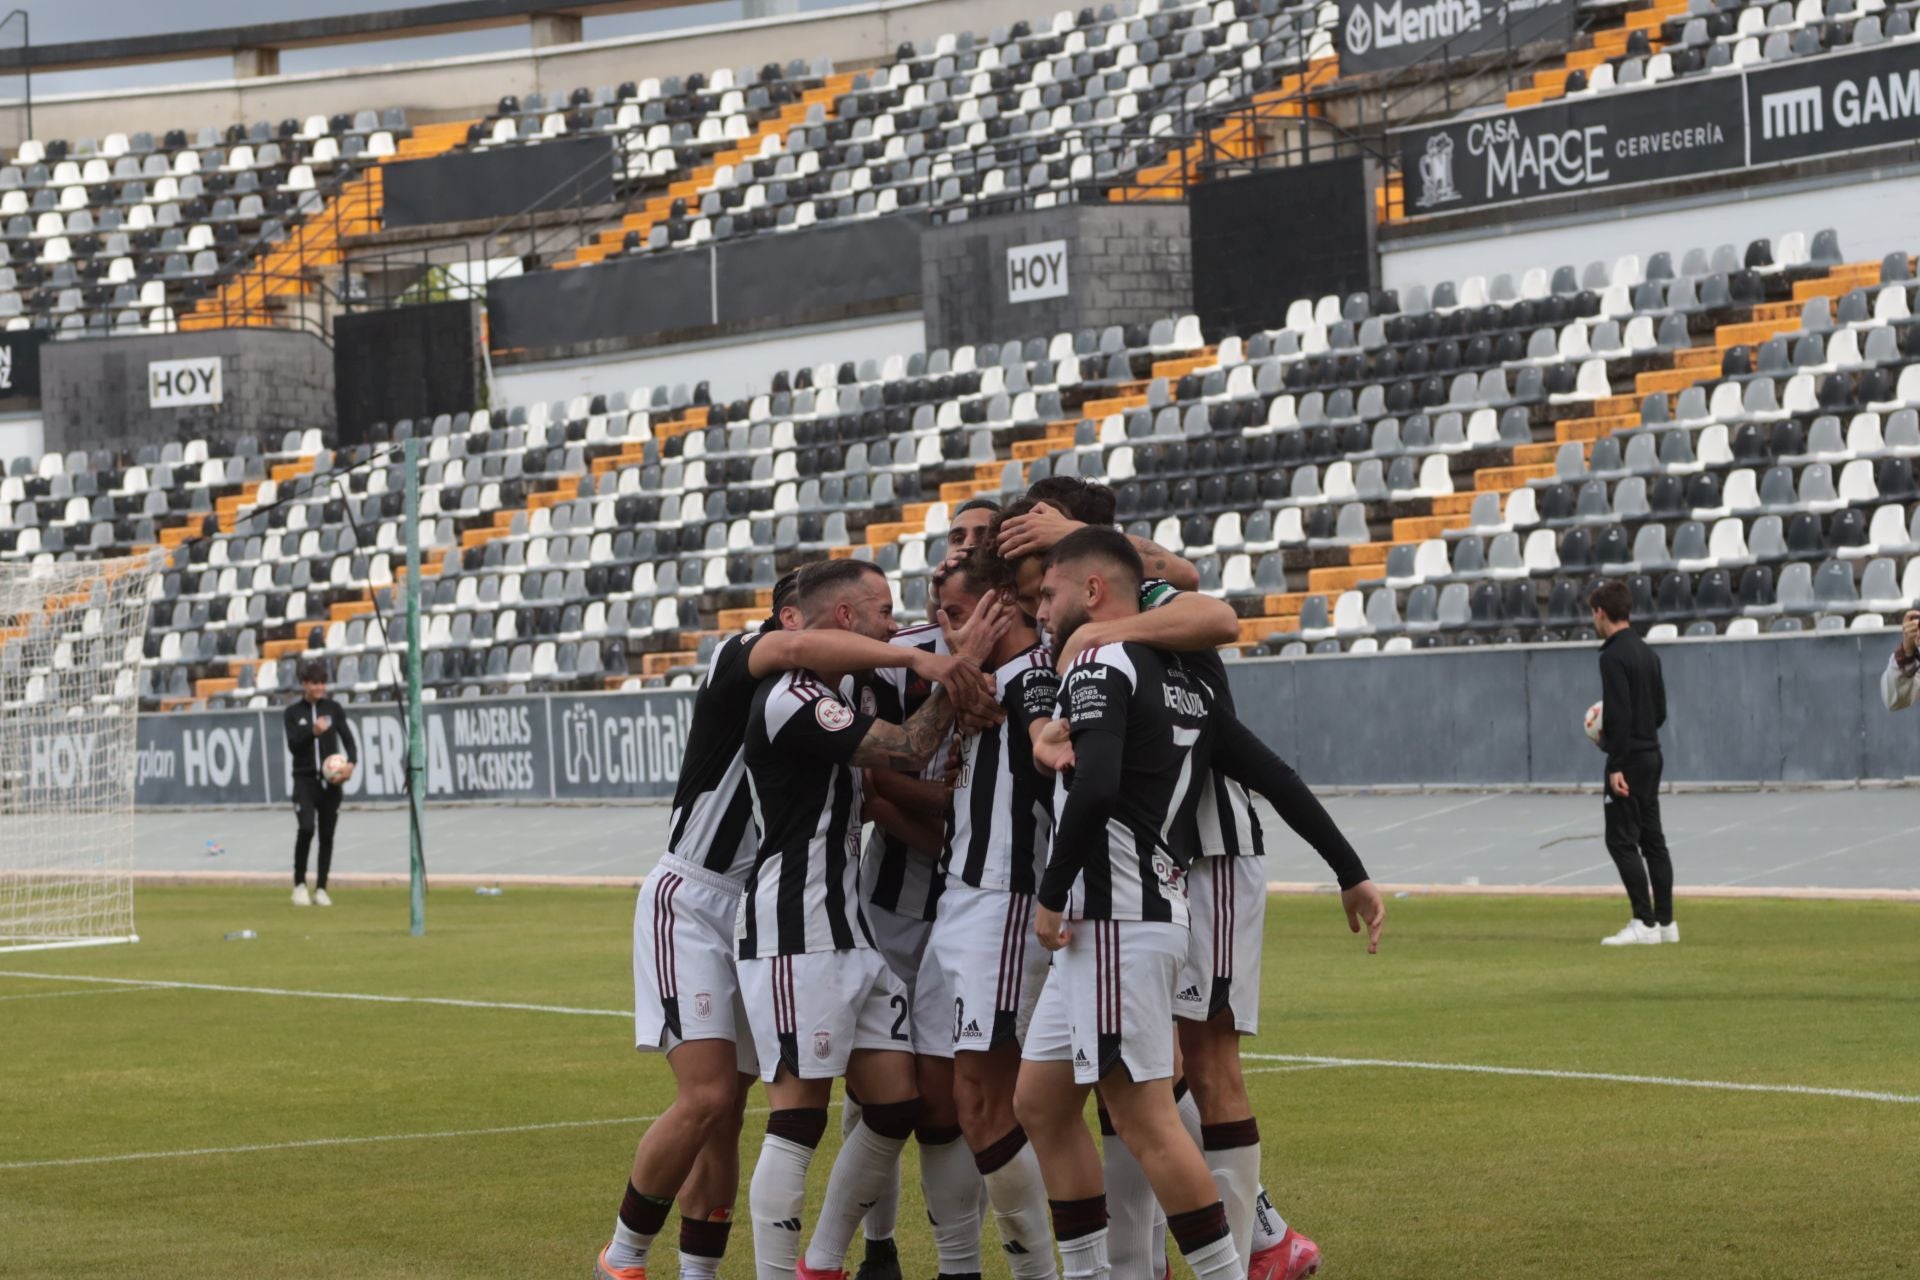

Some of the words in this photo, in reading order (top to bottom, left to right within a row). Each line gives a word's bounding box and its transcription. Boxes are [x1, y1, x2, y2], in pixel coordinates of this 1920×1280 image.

[1467, 117, 1520, 156] CASA
[1615, 122, 1724, 158] CERVECERÍA
[1487, 125, 1609, 198] MARCE
[1010, 251, 1063, 291] HOY
[153, 365, 217, 399] HOY
[454, 705, 532, 747] MADERAS
[31, 733, 96, 788] HOY
[182, 727, 253, 787] HOY
[456, 750, 534, 791] PACENSES
[890, 995, 909, 1041] 2
